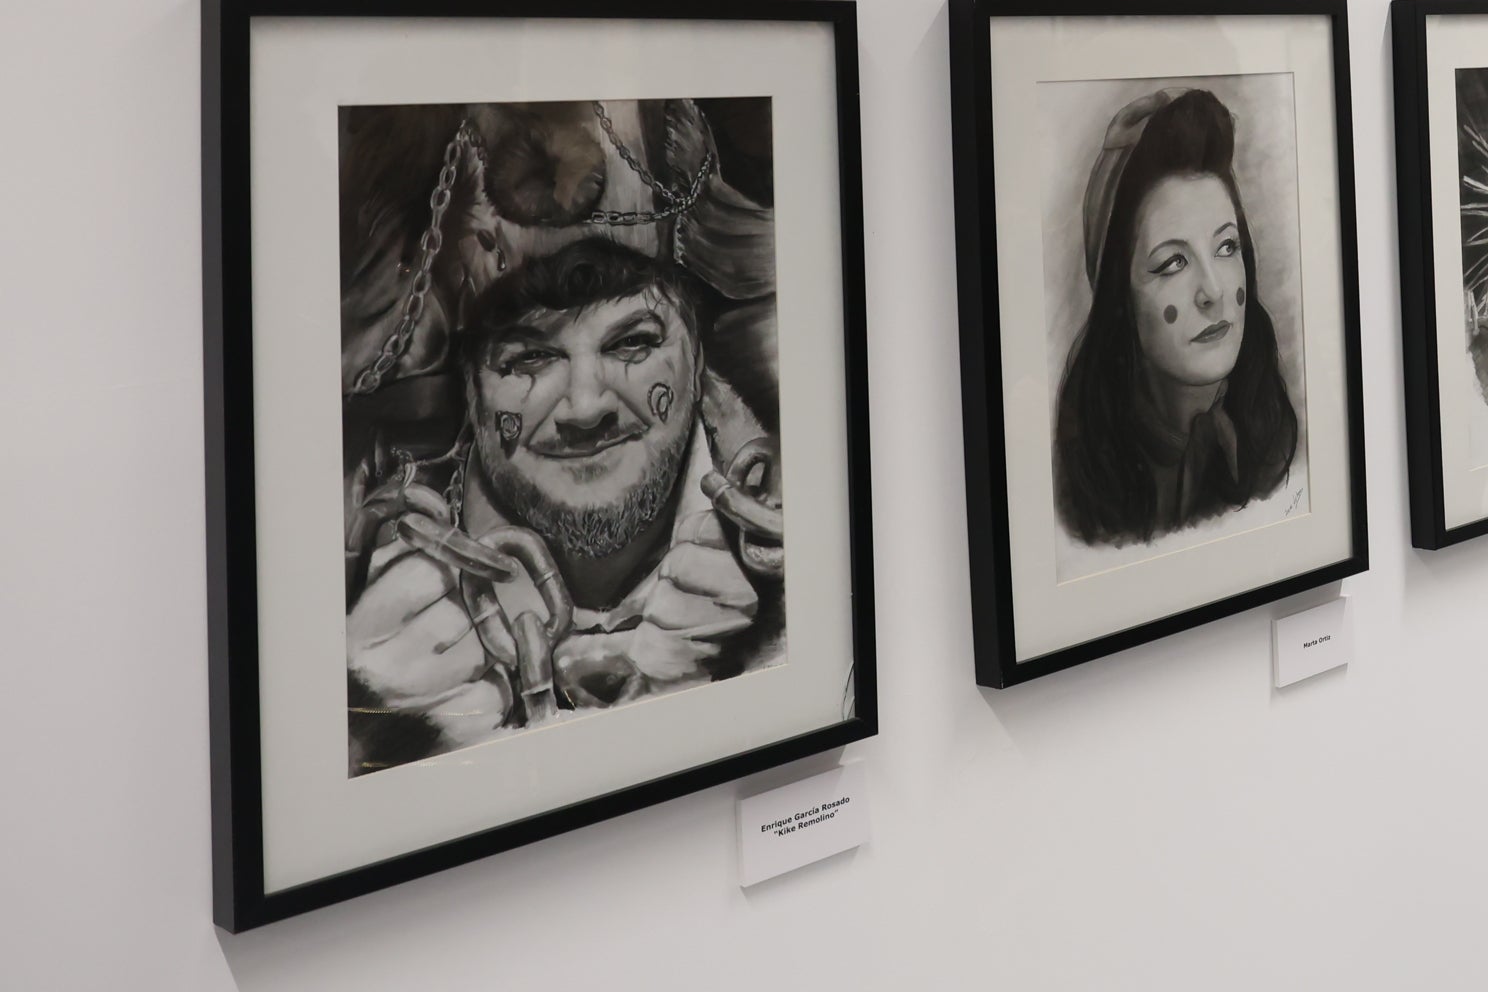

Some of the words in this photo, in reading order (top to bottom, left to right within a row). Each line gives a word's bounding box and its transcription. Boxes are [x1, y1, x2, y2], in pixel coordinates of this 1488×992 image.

[1303, 639, 1318, 648] Marta
[1319, 635, 1331, 643] Ortiz
[761, 816, 792, 832] Enrique
[794, 807, 820, 821] García
[821, 796, 850, 811] Rosado
[774, 825, 796, 837] “Kike
[798, 809, 839, 829] Remolino”
